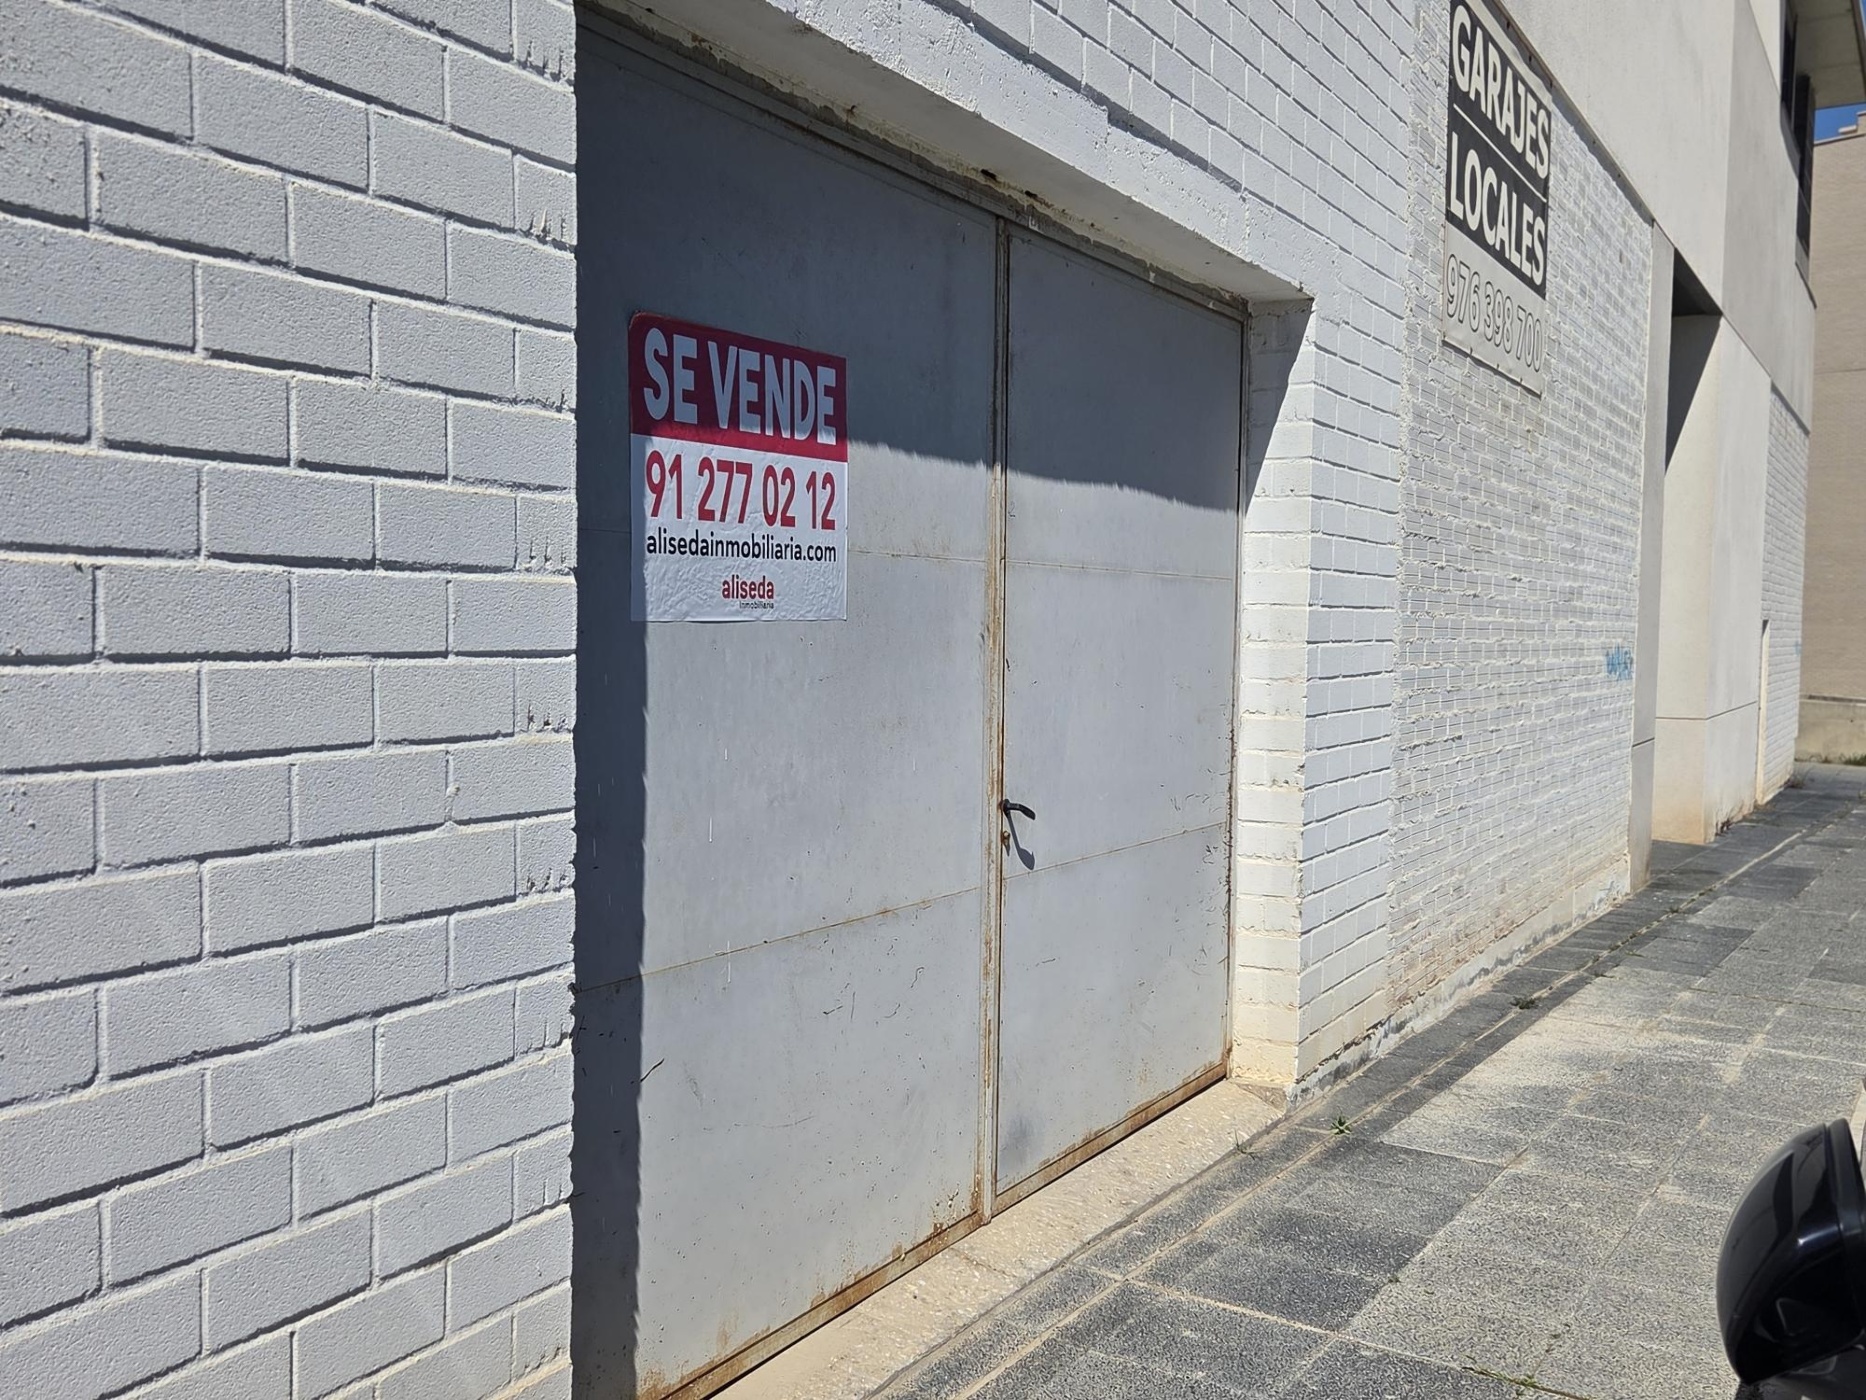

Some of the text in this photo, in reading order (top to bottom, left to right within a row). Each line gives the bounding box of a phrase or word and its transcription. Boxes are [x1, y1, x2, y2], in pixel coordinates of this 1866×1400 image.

[1452, 4, 1549, 180] GARAJES
[1451, 132, 1546, 287] LOCALES
[1447, 253, 1543, 373] 976 398 700
[643, 327, 837, 446] SE VENDE
[646, 449, 836, 531] 91 277 02 12
[646, 527, 837, 562] alisedainmobiliaria.com
[721, 574, 775, 600] aliseda
